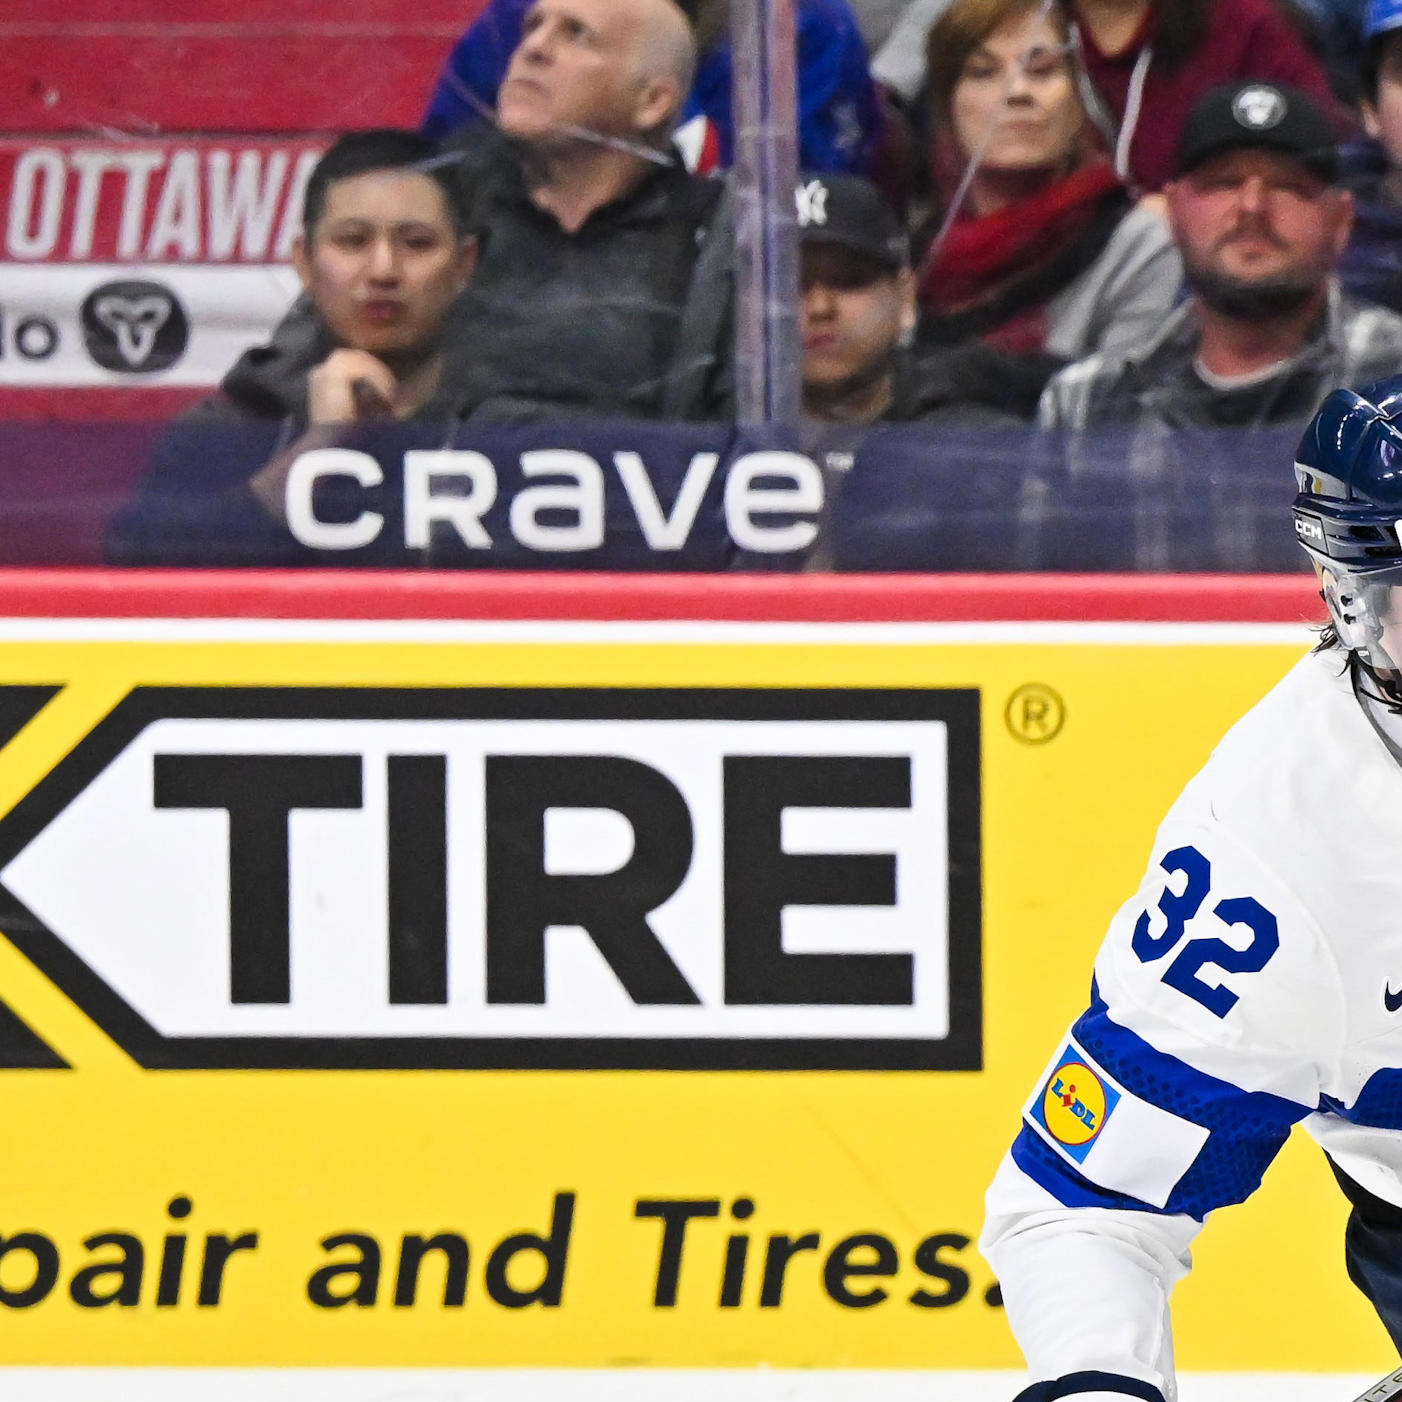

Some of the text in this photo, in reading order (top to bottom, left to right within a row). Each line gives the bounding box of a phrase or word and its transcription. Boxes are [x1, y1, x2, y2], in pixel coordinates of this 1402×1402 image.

[1294, 519, 1323, 541] CCM
[153, 753, 914, 1005] TIRE
[1130, 844, 1281, 1021] 32
[306, 1191, 576, 1310] and
